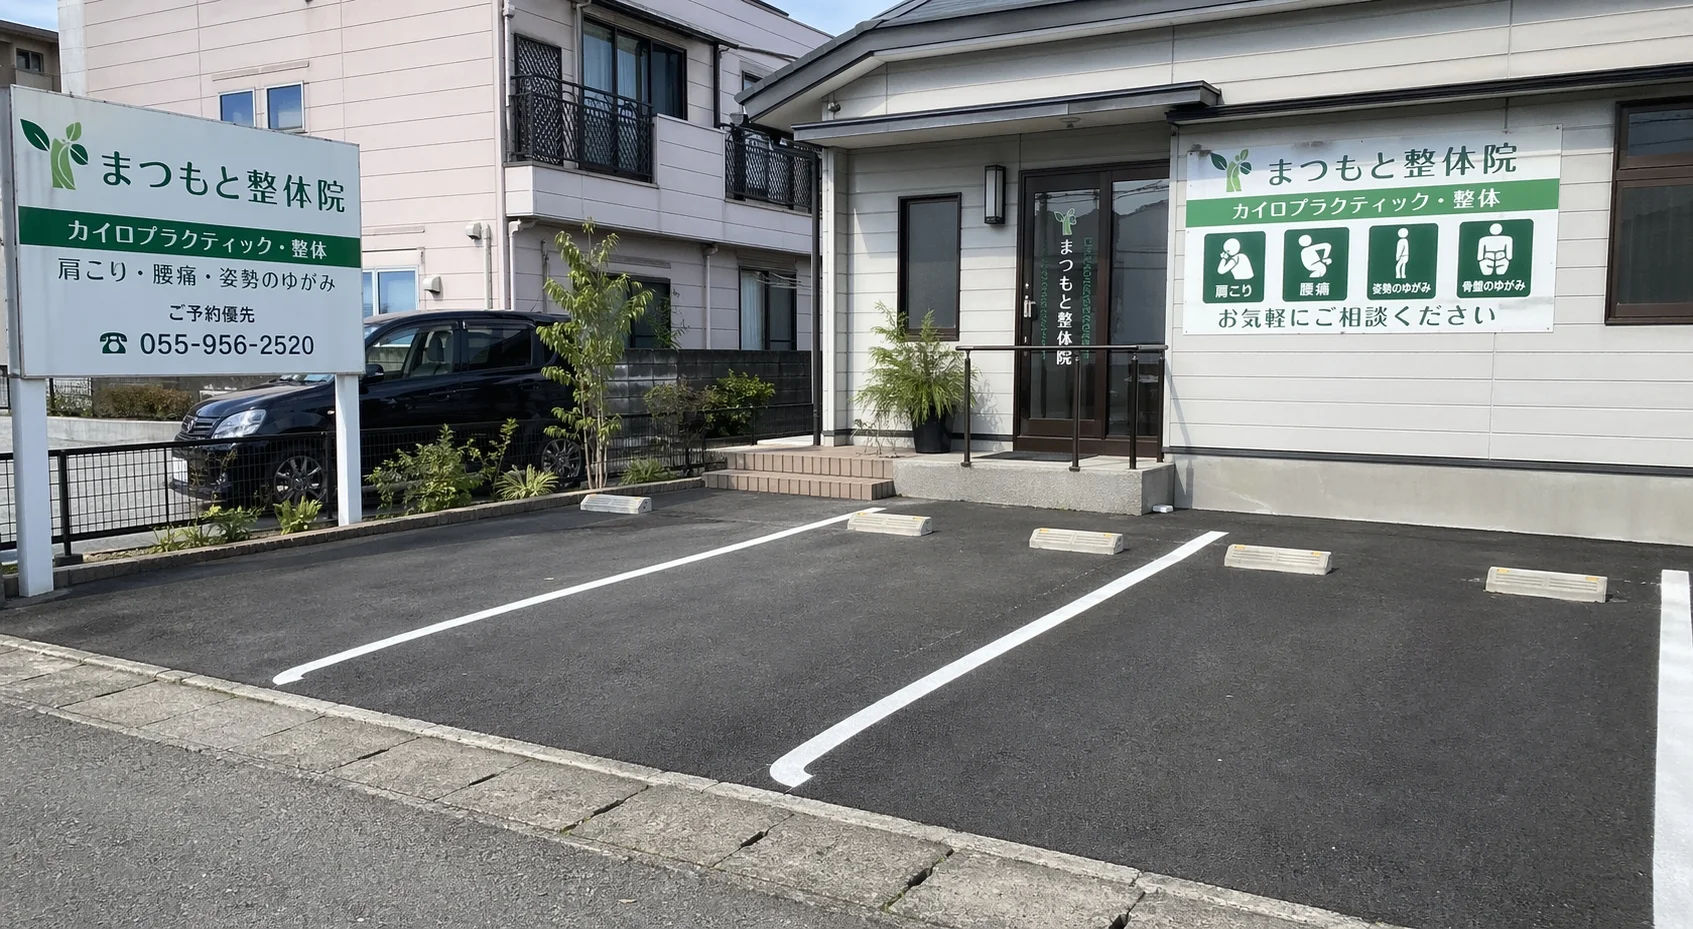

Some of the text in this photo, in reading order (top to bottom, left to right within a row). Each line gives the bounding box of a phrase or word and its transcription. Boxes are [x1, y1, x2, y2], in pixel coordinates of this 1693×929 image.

[1268, 142, 1517, 187] まつもと整体院
[101, 151, 345, 213] まつもと整体院
[1232, 188, 1500, 220] カイロプラクティック・整体
[68, 220, 328, 260] カイロプラクティック・整体
[58, 257, 336, 292] 肩こり・腰痛・姿勢のゆがみ
[1372, 282, 1432, 295] 姿勢のゆがみ
[1056, 239, 1074, 365] まつもと整体院
[1215, 284, 1252, 298] 肩こり
[1299, 282, 1330, 296] 腰痛
[169, 304, 256, 323] ご予約優先
[1218, 305, 1496, 329] お気軽にご相談ください
[140, 333, 315, 356] 055-956-2520
